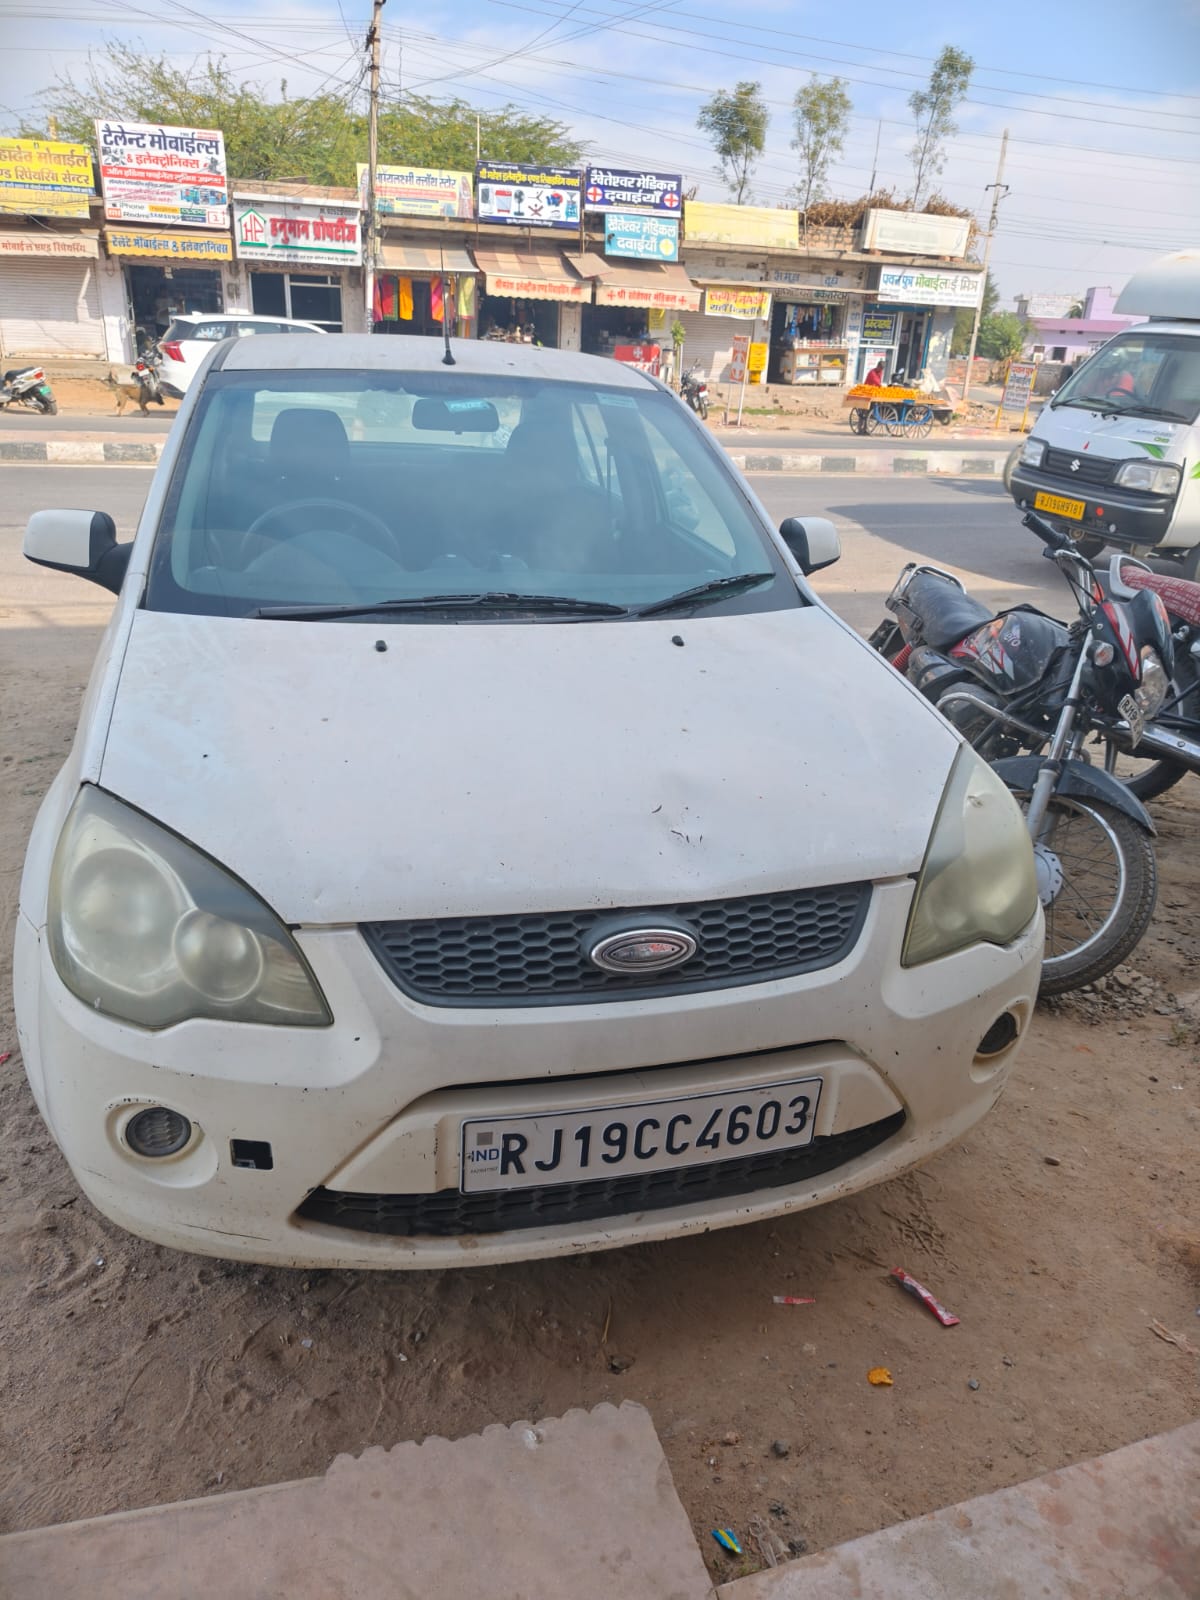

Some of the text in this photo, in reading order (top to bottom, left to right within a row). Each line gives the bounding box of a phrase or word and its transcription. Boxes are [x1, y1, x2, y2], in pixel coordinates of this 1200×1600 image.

[148, 128, 220, 155] मोबाईल्स
[636, 174, 678, 191] मेडिकल
[270, 217, 309, 244] हनुमान
[499, 1094, 813, 1177] RJ19CC4603
[471, 1148, 499, 1162] IND
